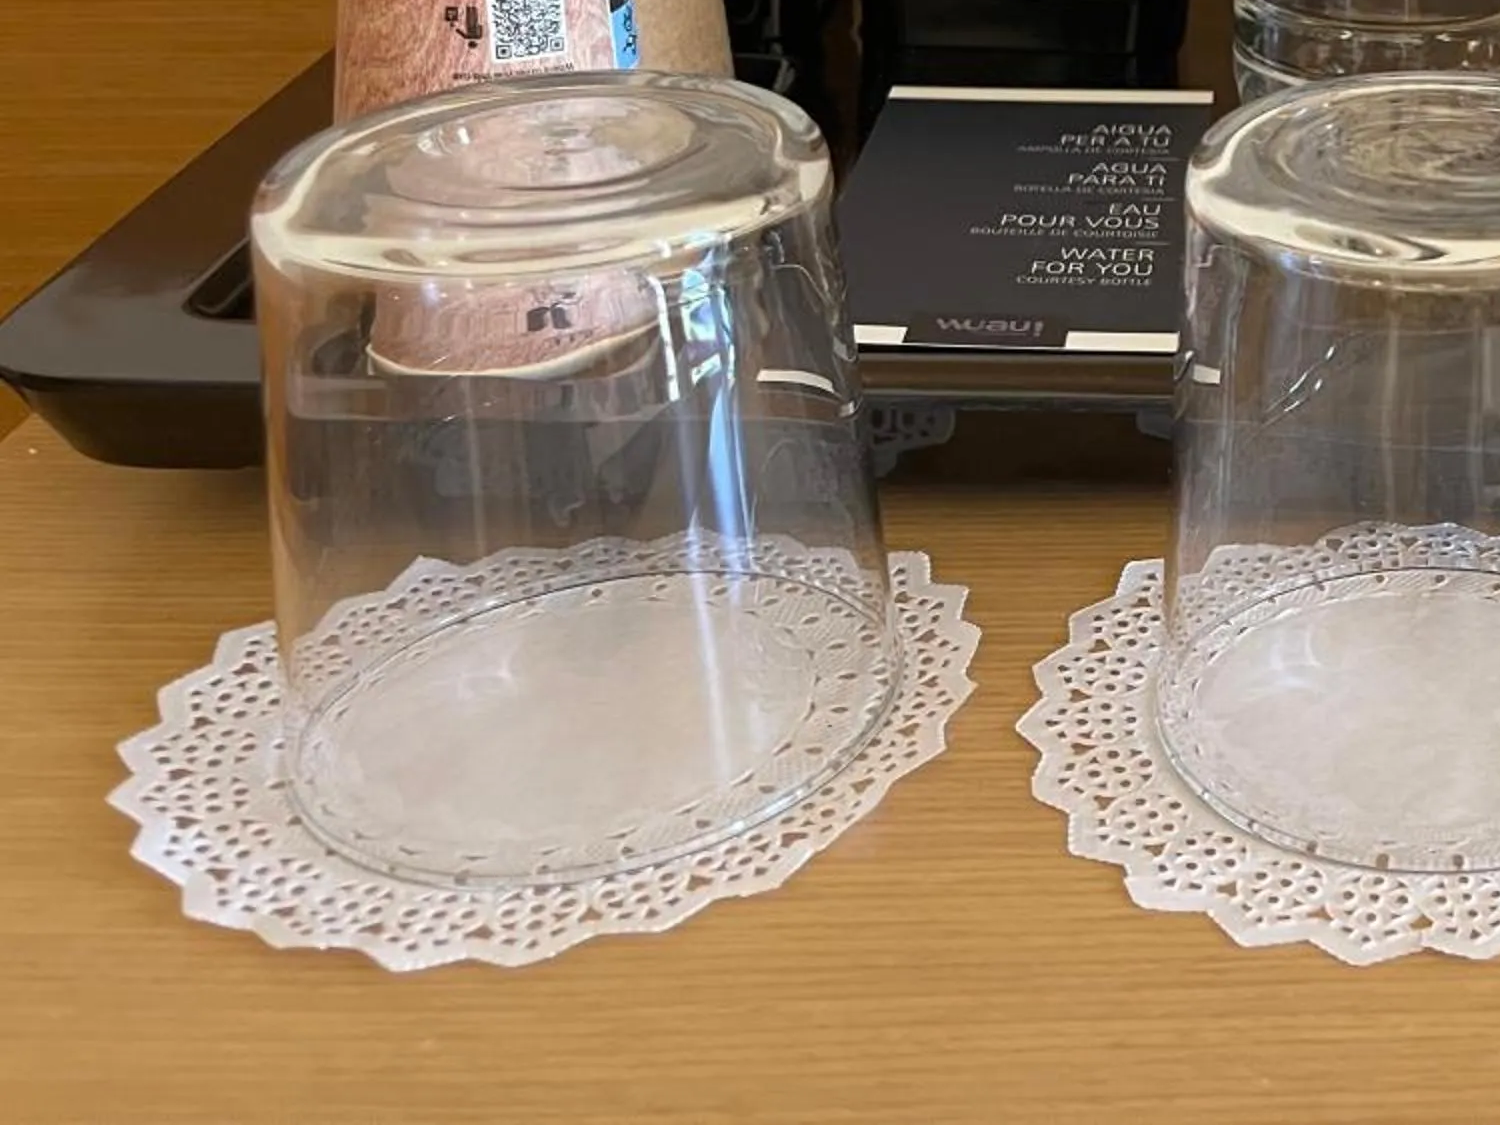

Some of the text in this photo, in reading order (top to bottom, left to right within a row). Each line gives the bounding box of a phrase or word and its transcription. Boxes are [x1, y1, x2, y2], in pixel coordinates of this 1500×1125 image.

[1093, 123, 1172, 136] AIGUA
[1060, 134, 1171, 149] PER A TU
[1091, 161, 1168, 175] AGUA
[1067, 172, 1166, 188] PARA TI
[1108, 202, 1162, 216] EAU
[1000, 213, 1160, 230] POUR VOUS
[1060, 246, 1155, 262] WATER
[1030, 260, 1153, 277] FOR YOU
